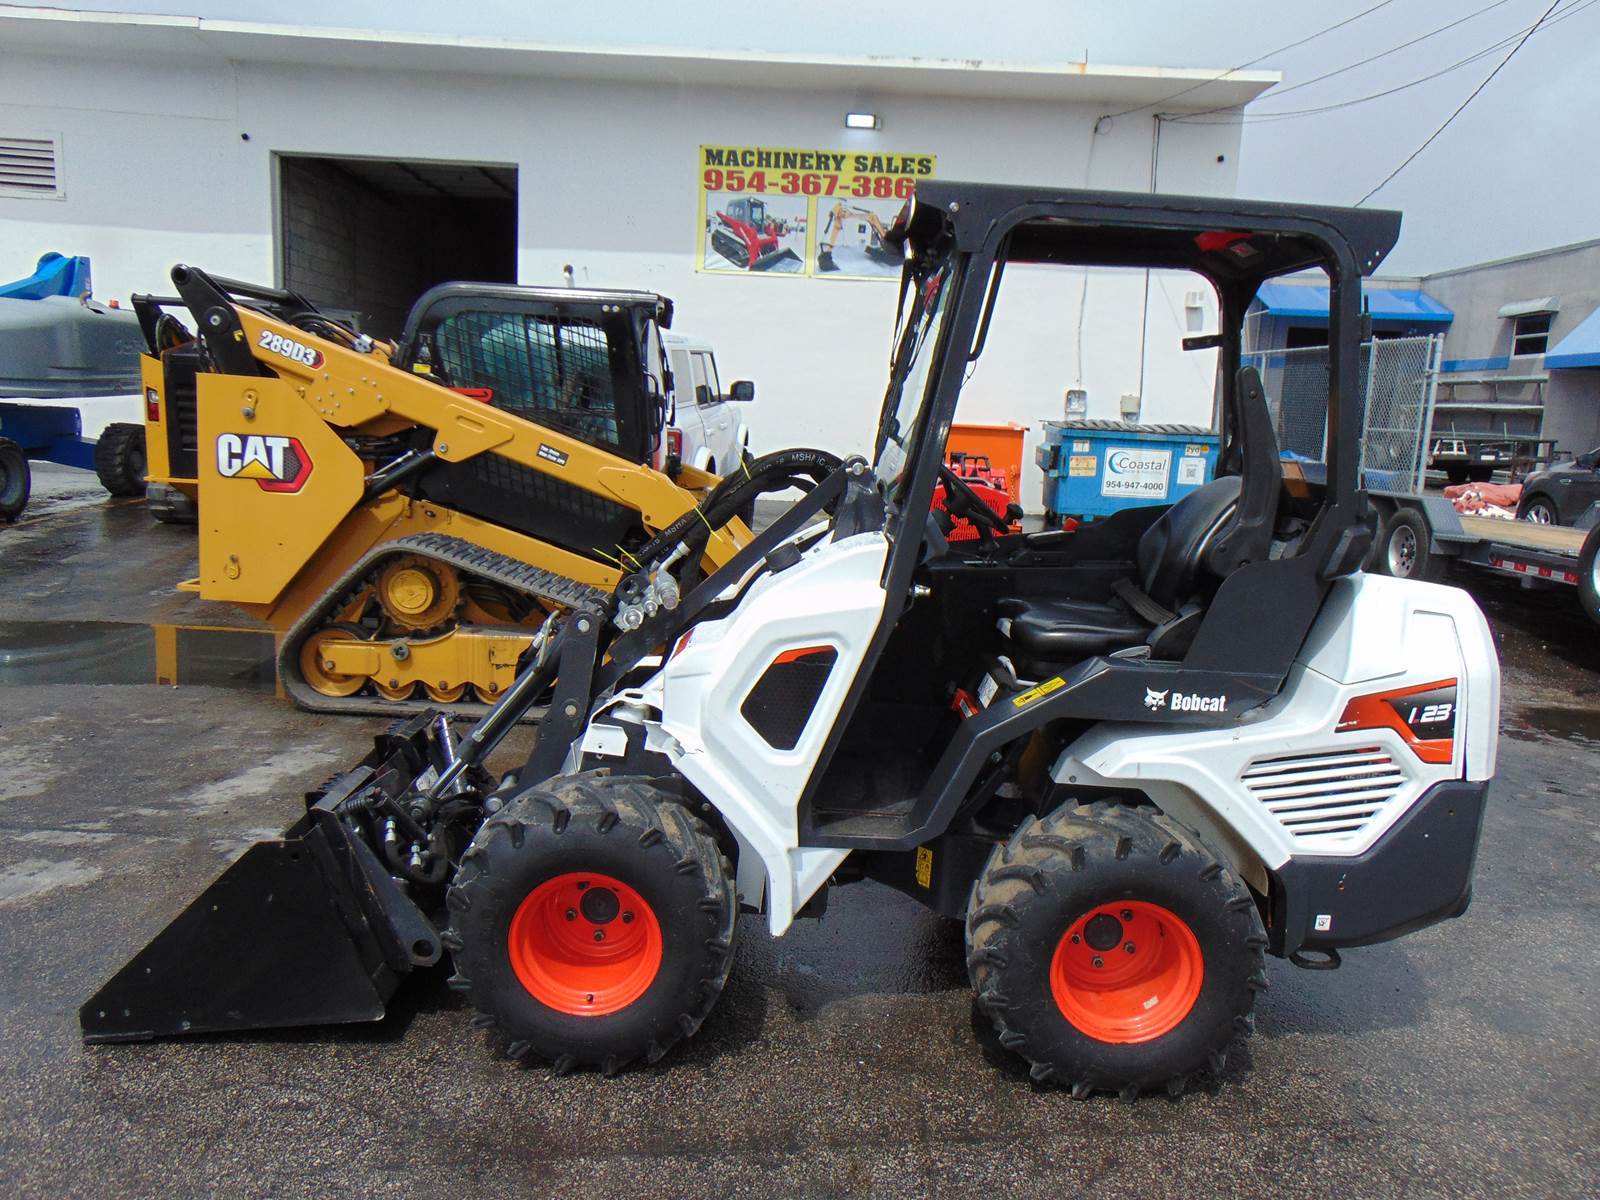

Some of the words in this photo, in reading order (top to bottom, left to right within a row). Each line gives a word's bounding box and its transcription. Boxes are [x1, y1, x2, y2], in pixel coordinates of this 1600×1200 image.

[705, 149, 846, 172] MACHINERY
[854, 155, 932, 175] SALES
[704, 169, 916, 199] 954-367-386
[258, 330, 317, 366] 289D3
[218, 434, 290, 480] CAT
[1119, 457, 1167, 471] Coastal
[1105, 480, 1164, 491] 954-947-4000
[1171, 692, 1227, 712] Bobcat
